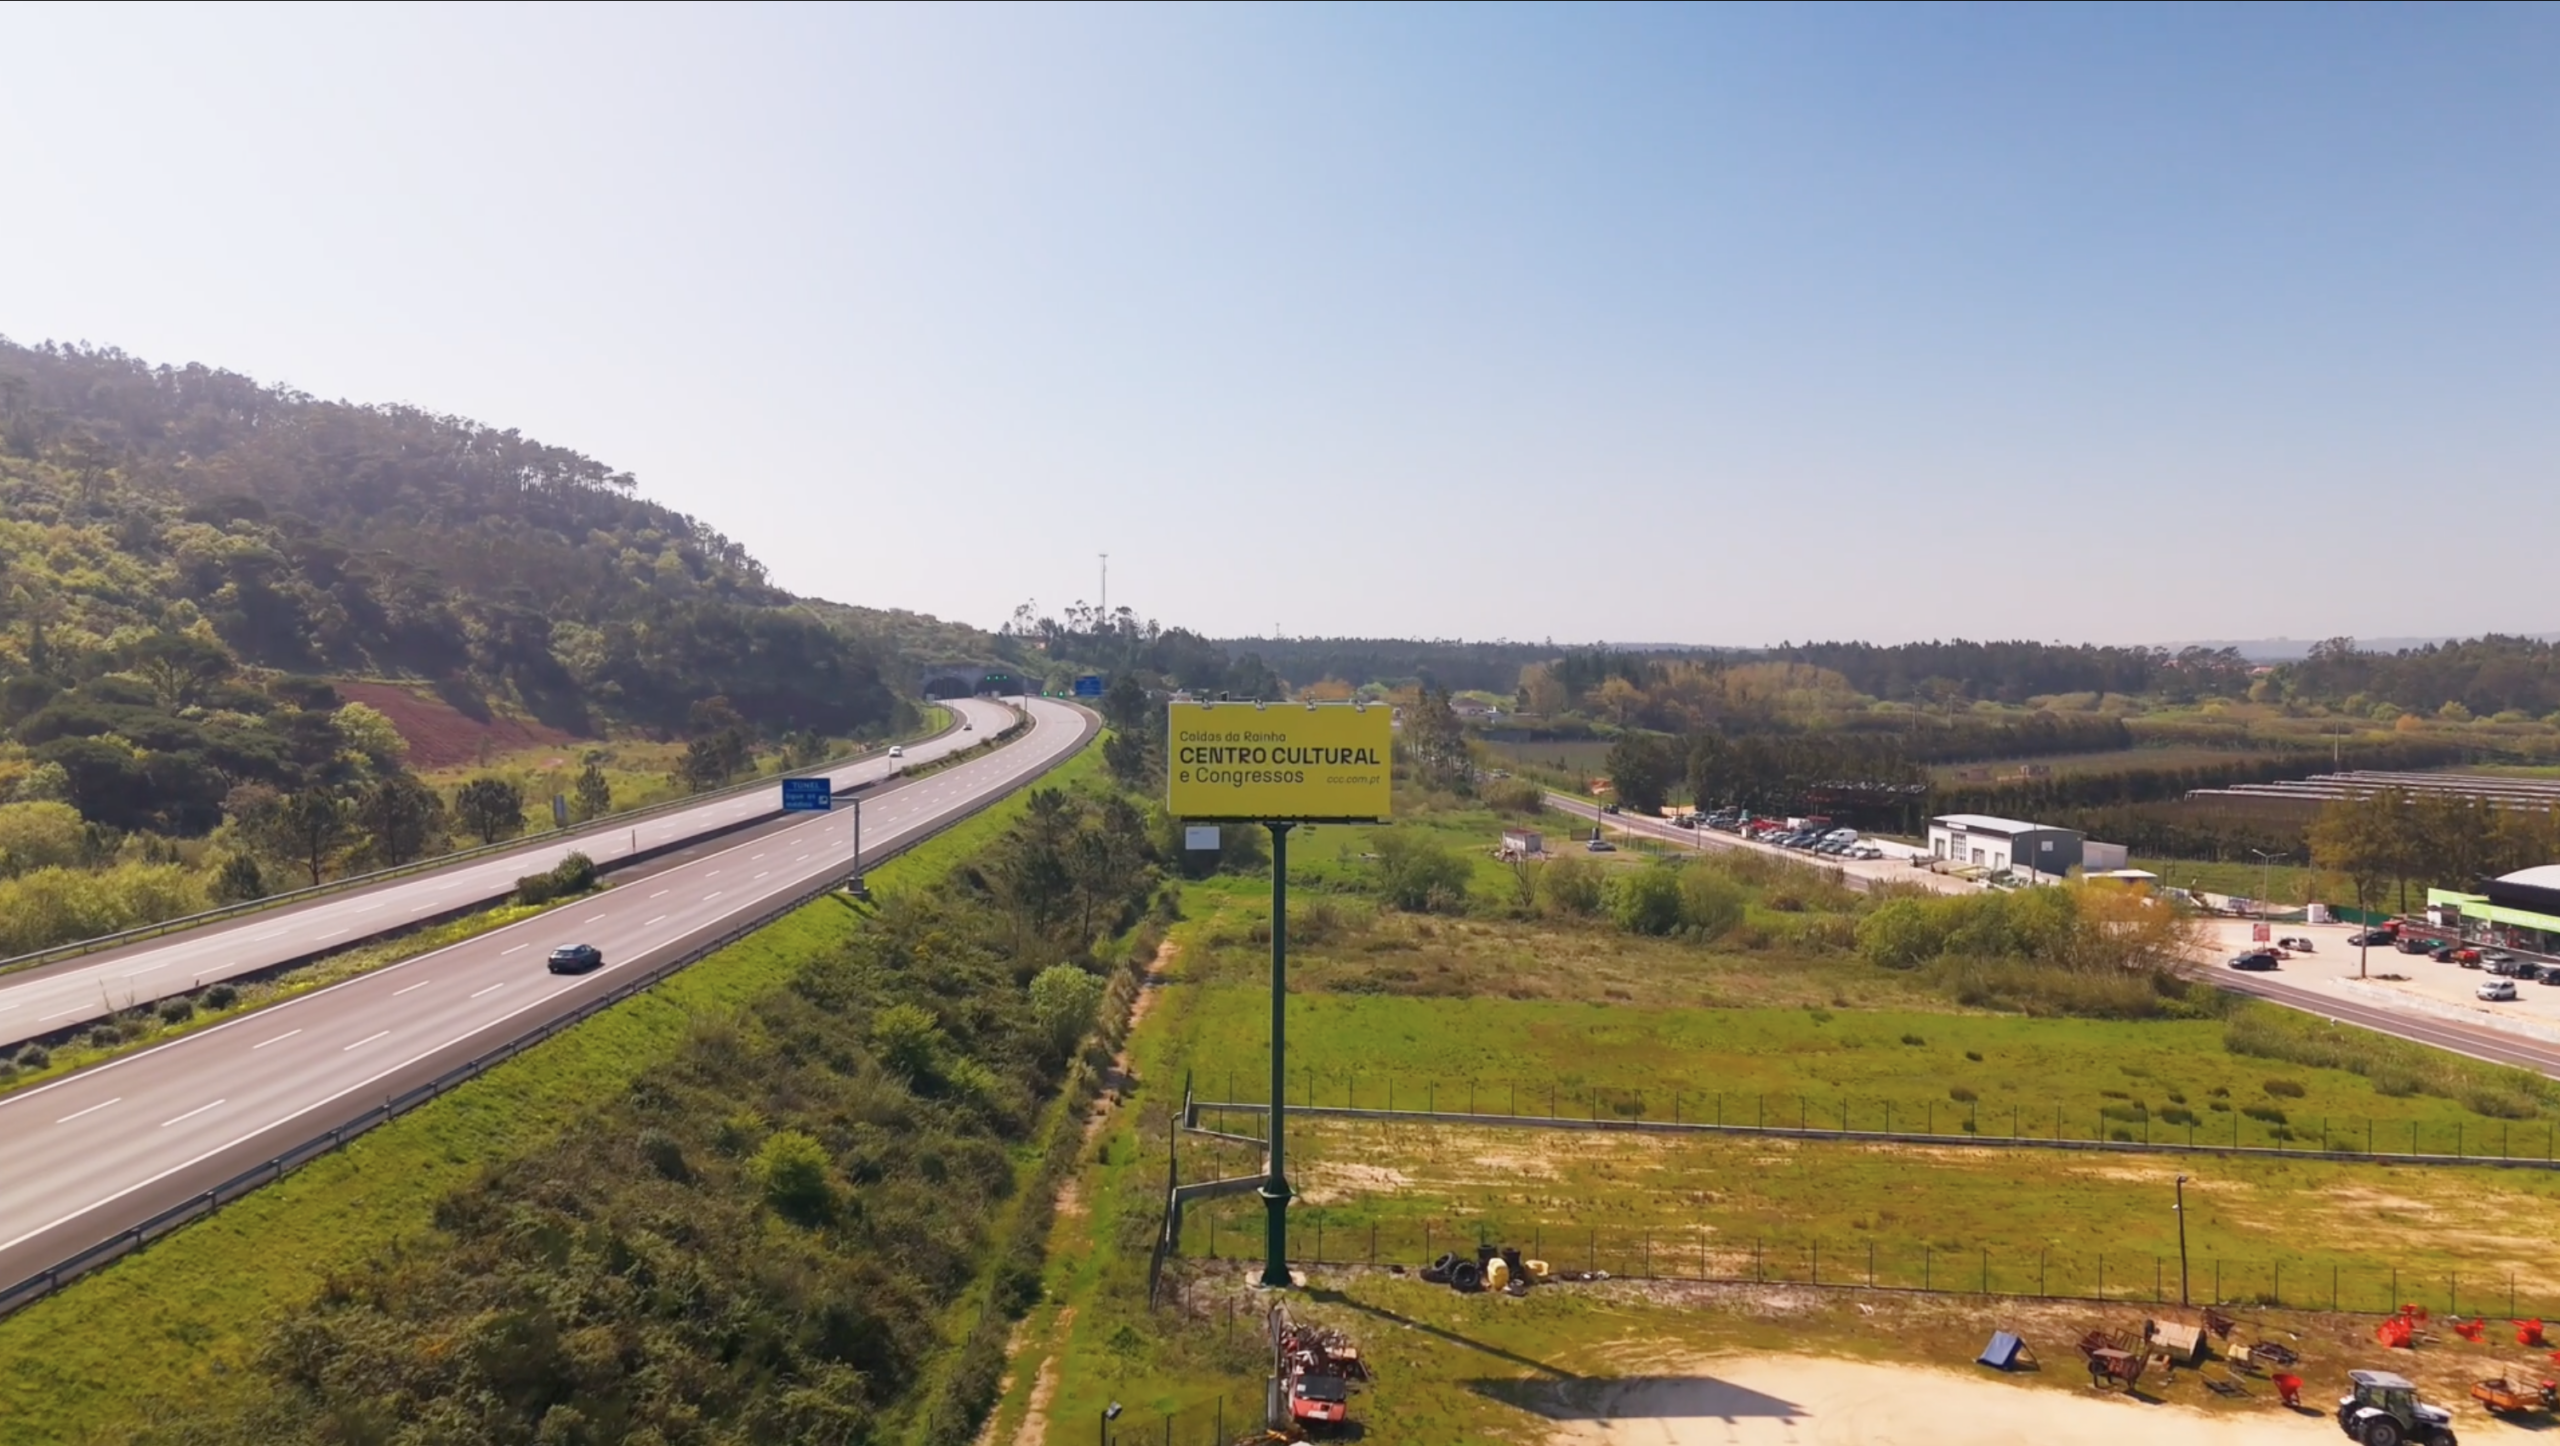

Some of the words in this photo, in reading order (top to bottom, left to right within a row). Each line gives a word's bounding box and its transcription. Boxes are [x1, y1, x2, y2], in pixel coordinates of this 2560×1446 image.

[1179, 730, 1222, 742] Caldas
[1225, 730, 1240, 742] da
[1244, 730, 1286, 742] Rainha
[1179, 746, 1267, 764] CENTRO
[1271, 747, 1381, 765] CULTURAL
[1179, 770, 1190, 783] e
[1196, 766, 1304, 788] Congressos
[1326, 774, 1381, 785] ccc.com.pt
